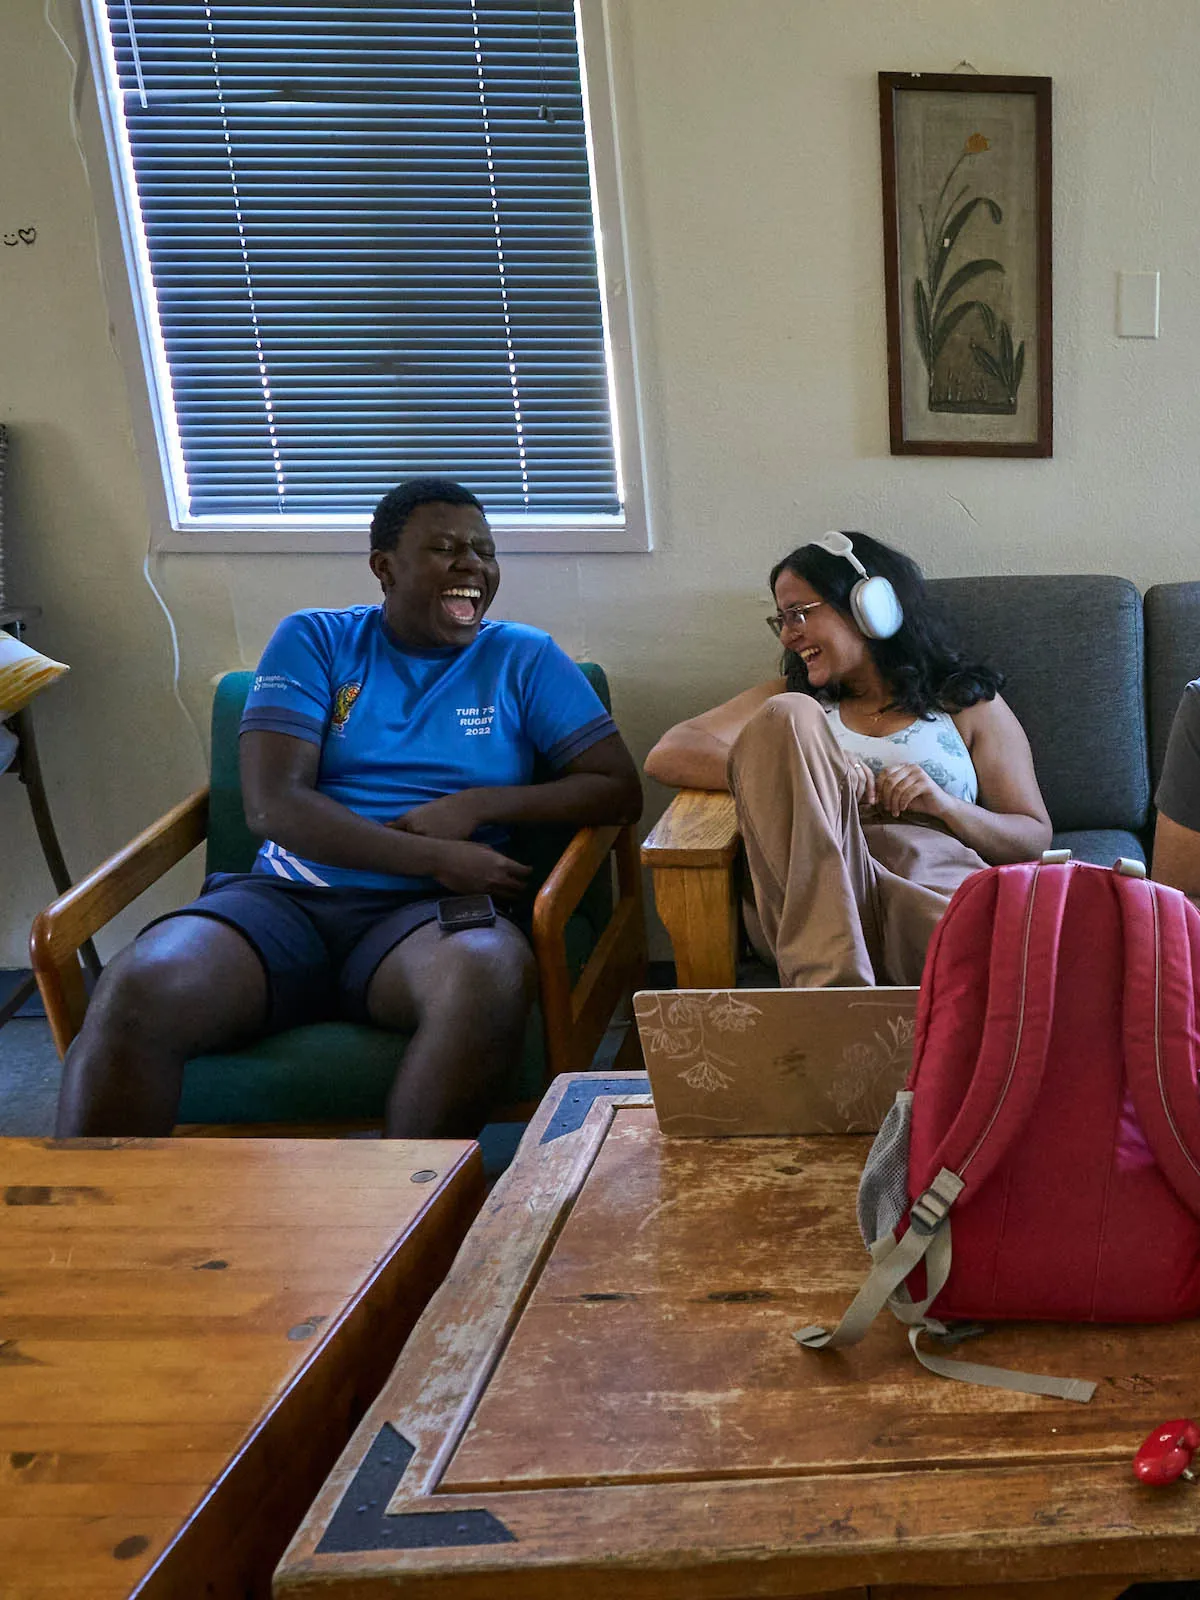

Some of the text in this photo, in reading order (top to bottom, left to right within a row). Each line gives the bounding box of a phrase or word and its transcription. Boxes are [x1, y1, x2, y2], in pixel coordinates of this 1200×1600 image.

[456, 708, 479, 716] TURI
[460, 715, 494, 726] RUGBY
[465, 726, 491, 736] 2022
